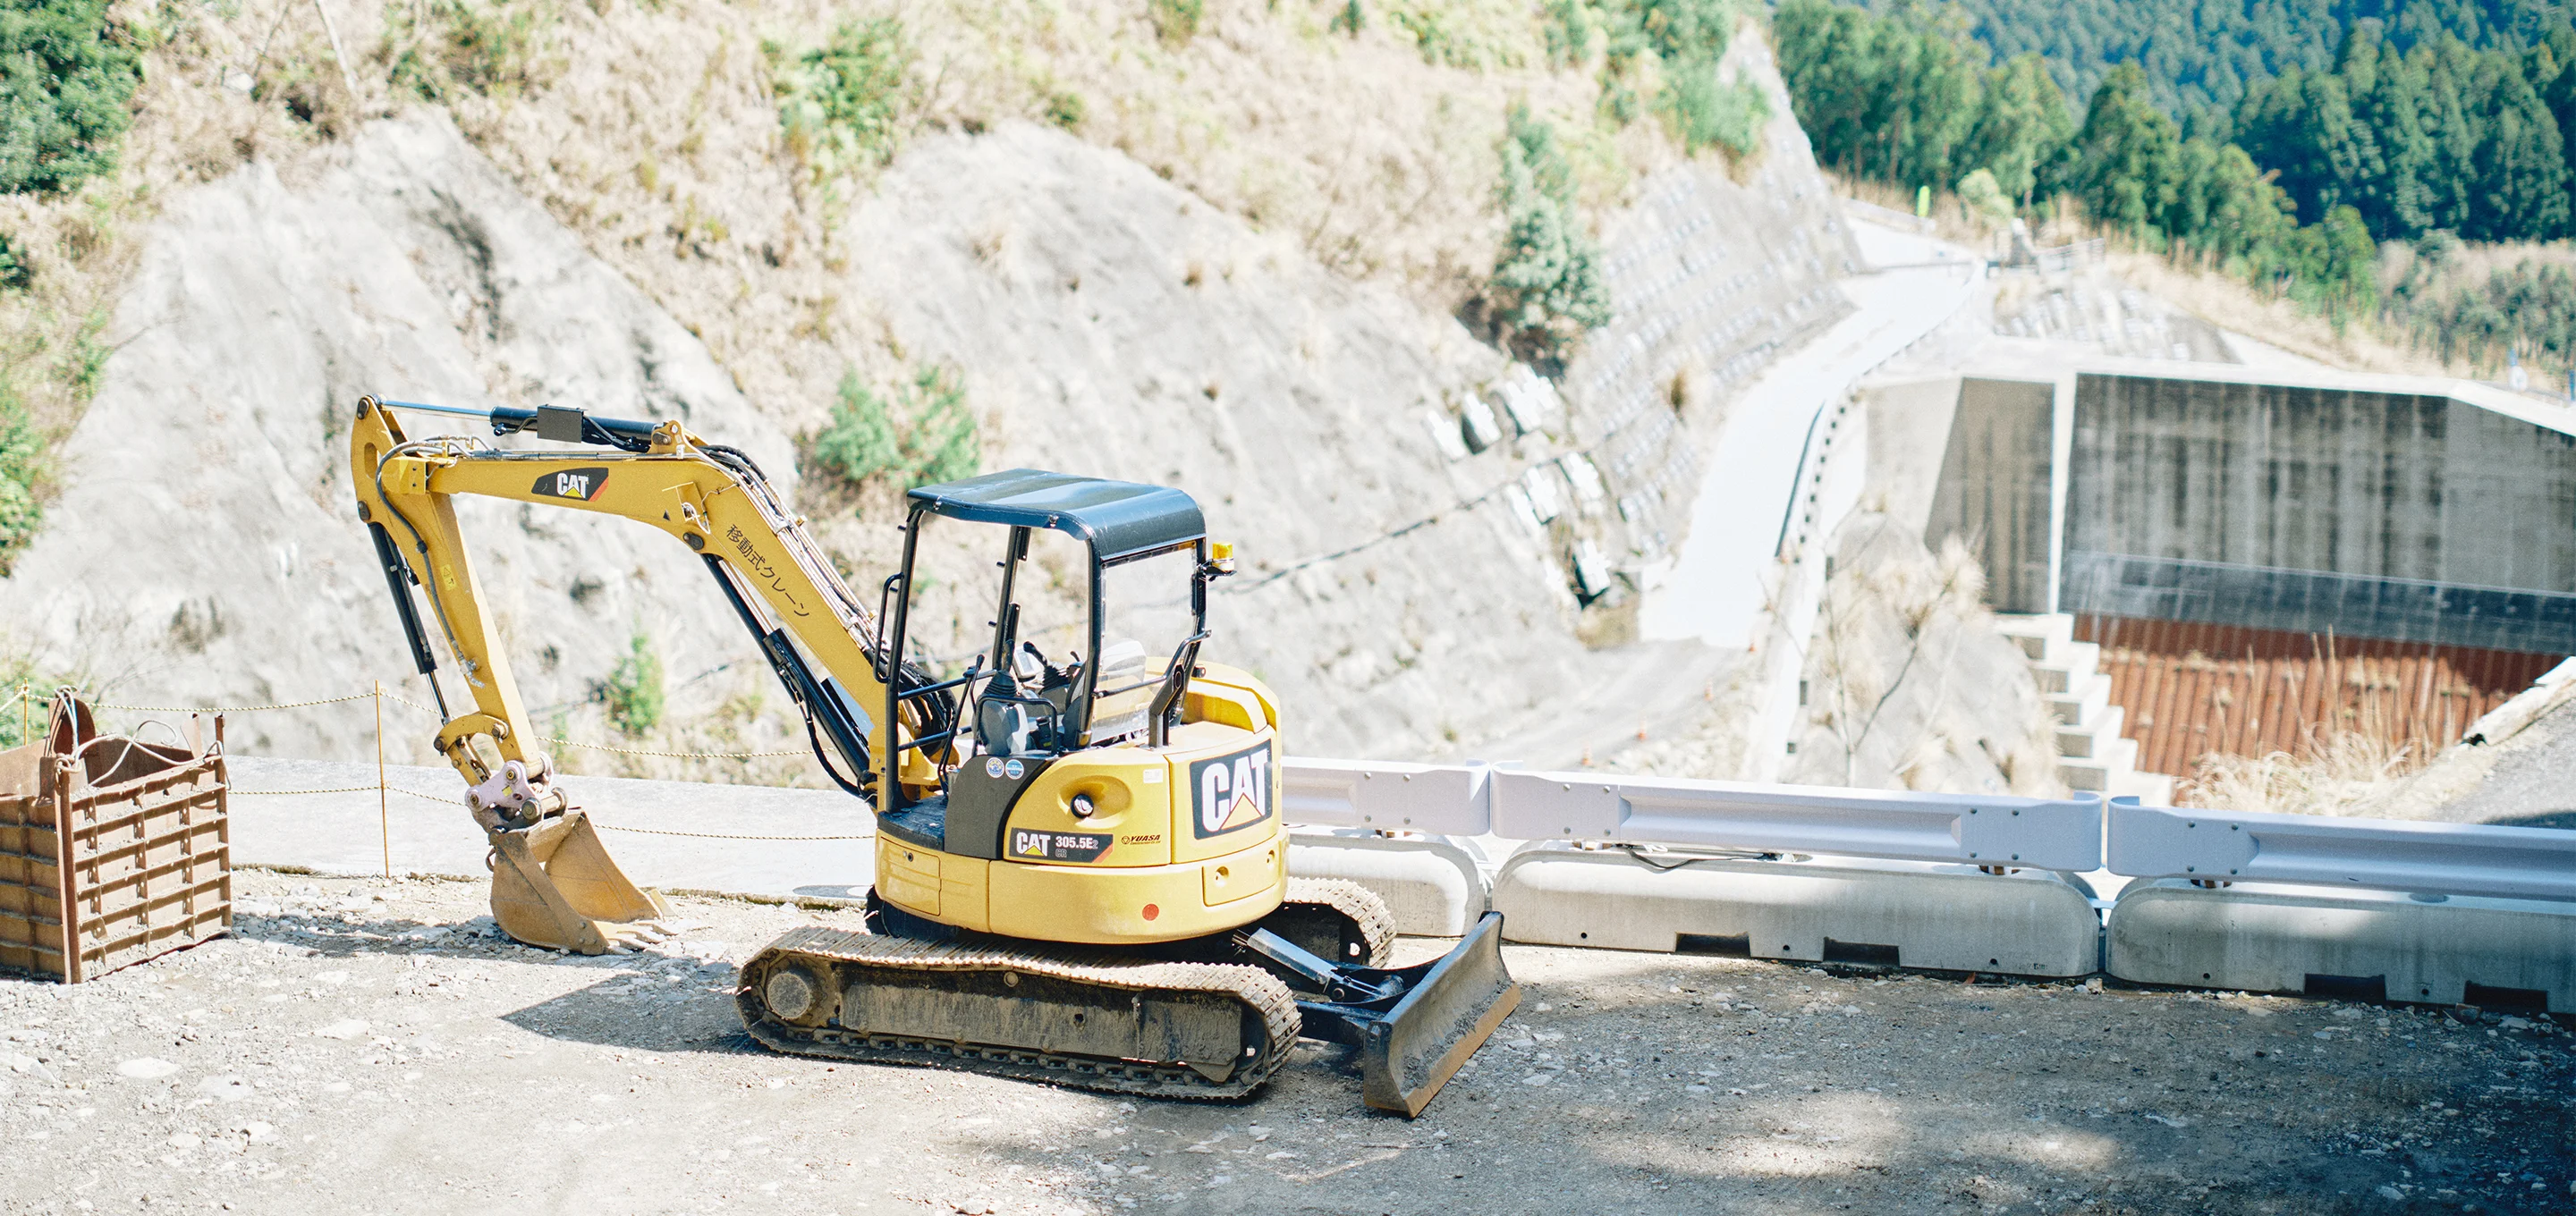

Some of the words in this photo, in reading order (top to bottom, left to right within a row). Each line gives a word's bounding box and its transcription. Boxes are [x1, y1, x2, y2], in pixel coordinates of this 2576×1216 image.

[556, 472, 589, 499] CAT
[726, 524, 809, 617] 移動式クレーン
[1201, 748, 1268, 832] CAT
[1016, 832, 1051, 857] CAT
[1055, 835, 1099, 849] 305.5E2
[1055, 849, 1067, 858] CR
